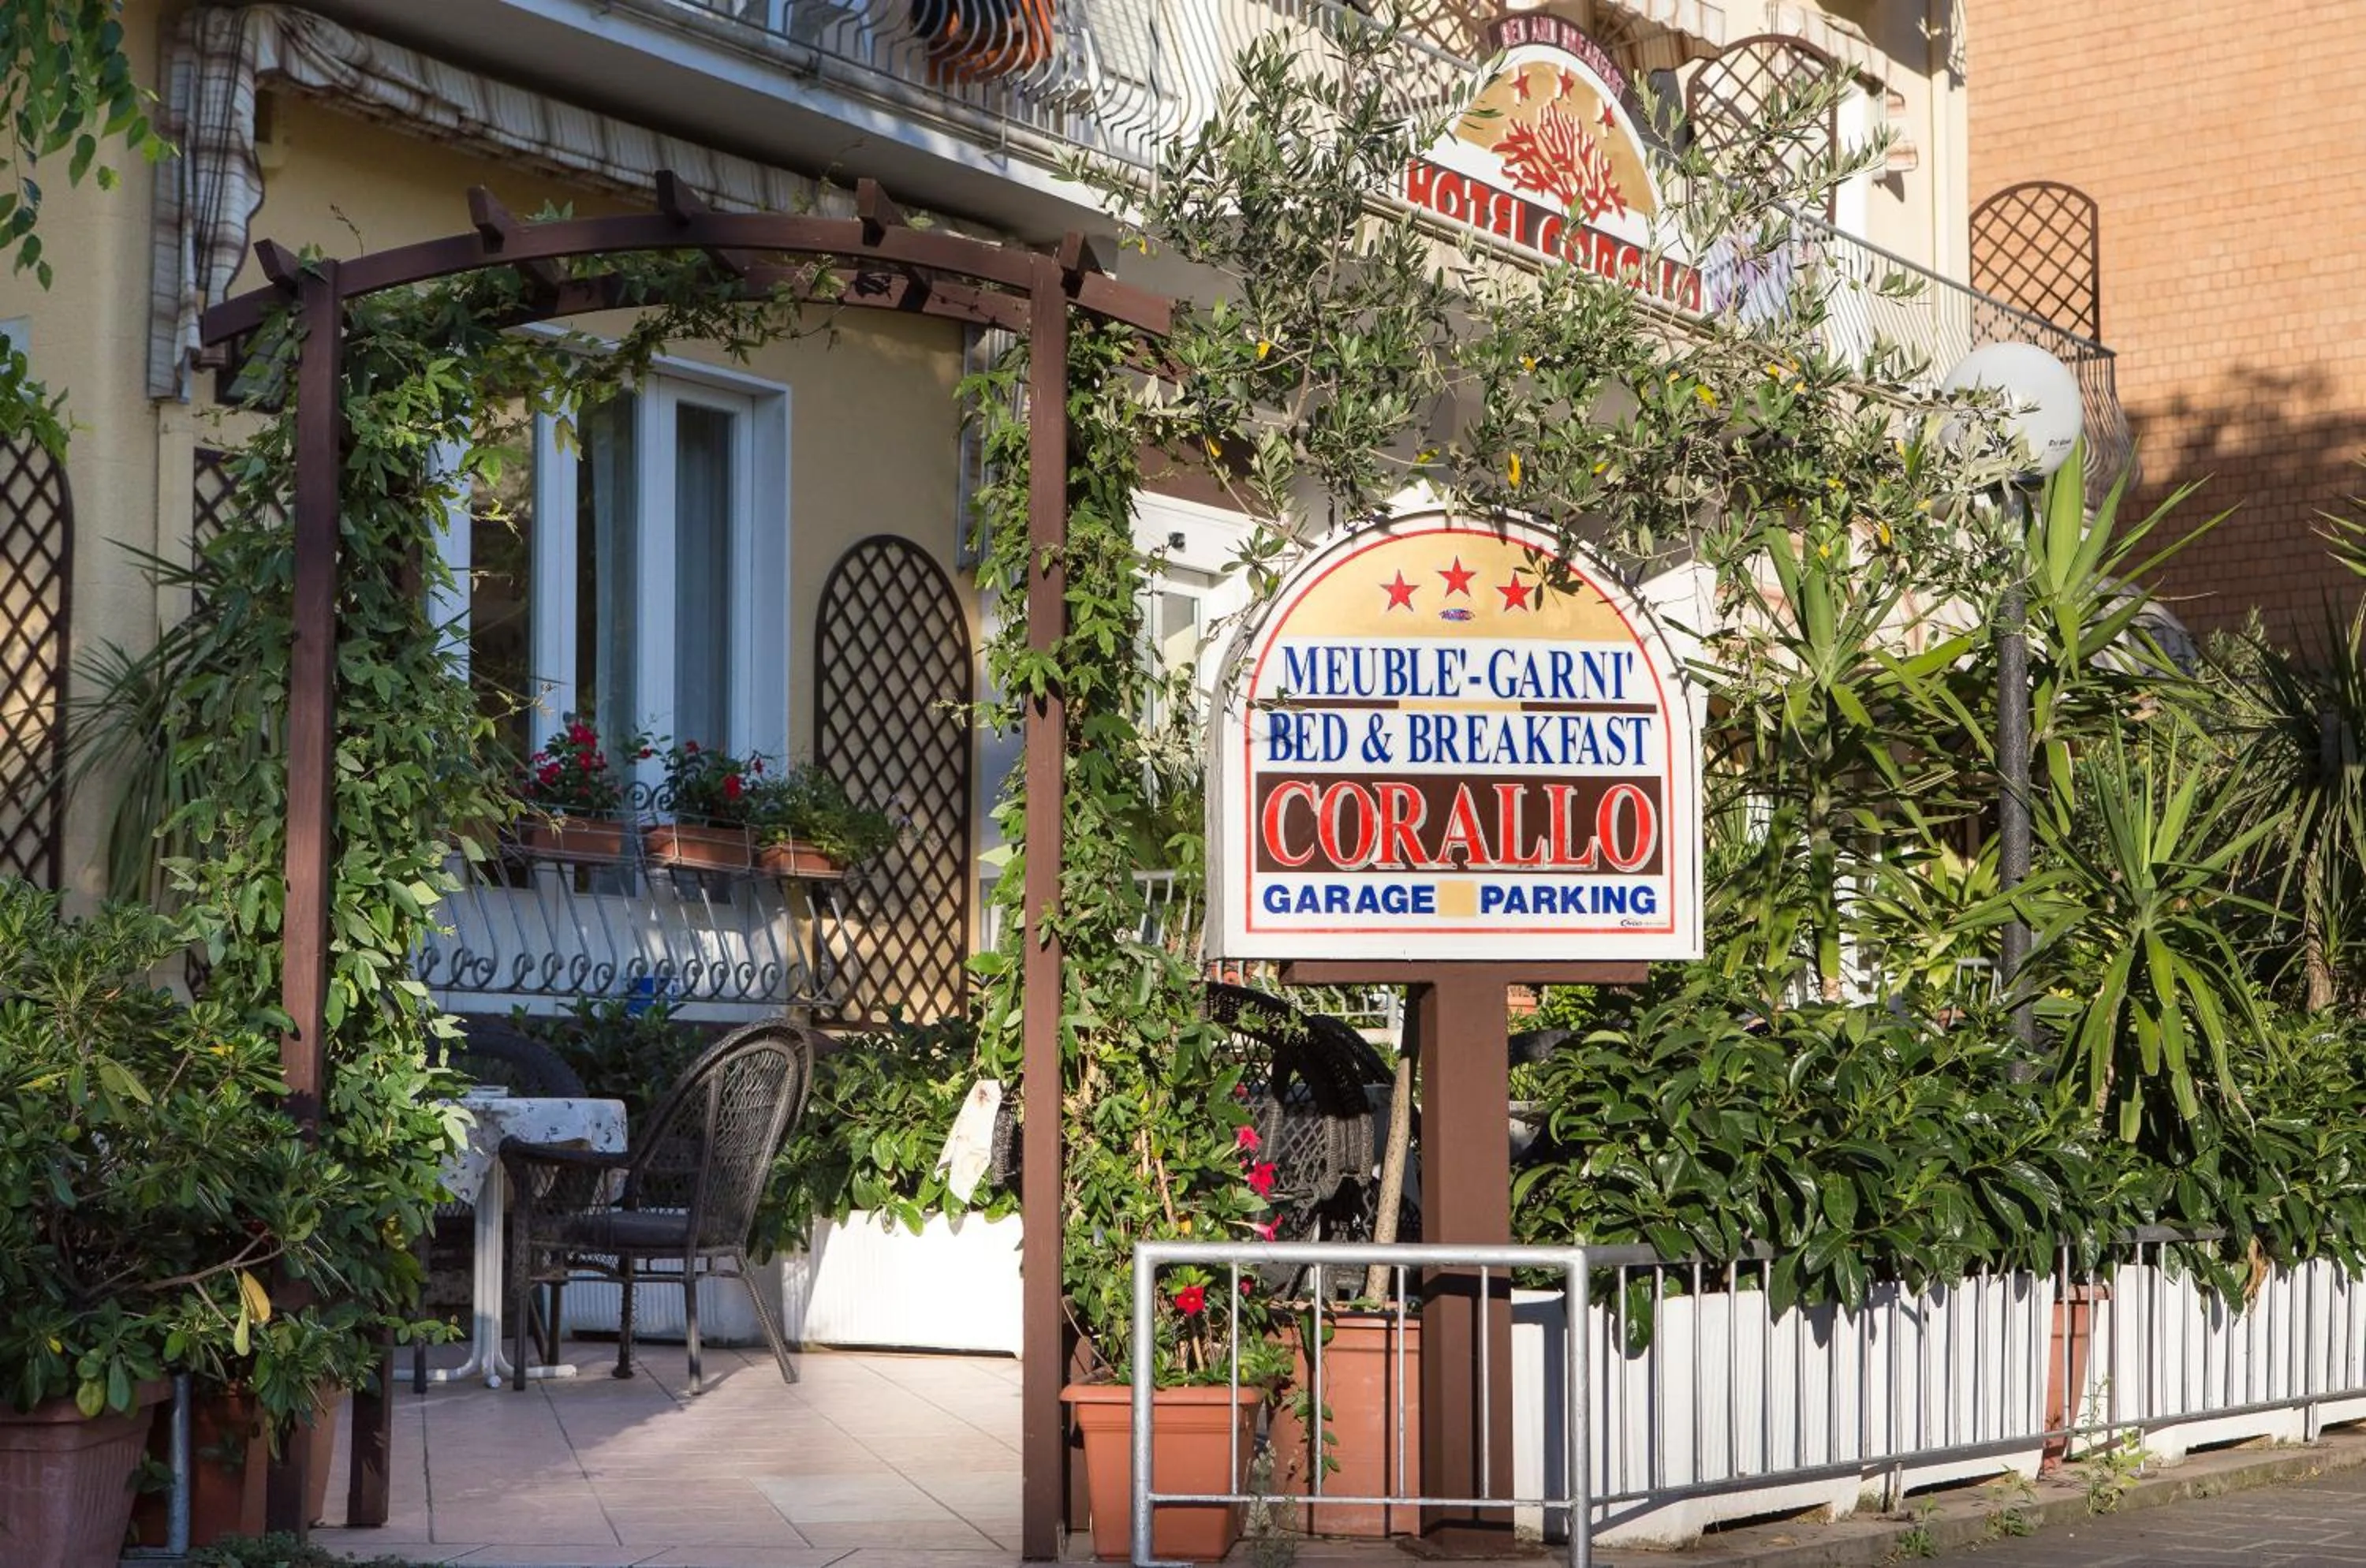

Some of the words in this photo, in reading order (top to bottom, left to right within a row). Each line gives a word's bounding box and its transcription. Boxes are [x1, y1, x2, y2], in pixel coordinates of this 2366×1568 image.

[1404, 158, 1525, 243] HOTEL
[1267, 713, 1348, 762] BED
[1362, 713, 1394, 763] &
[1406, 715, 1651, 765] BREAKFAST
[1263, 781, 1658, 872] CORALLO
[1263, 884, 1435, 914] GARAGE
[1480, 885, 1655, 914] PARKING
